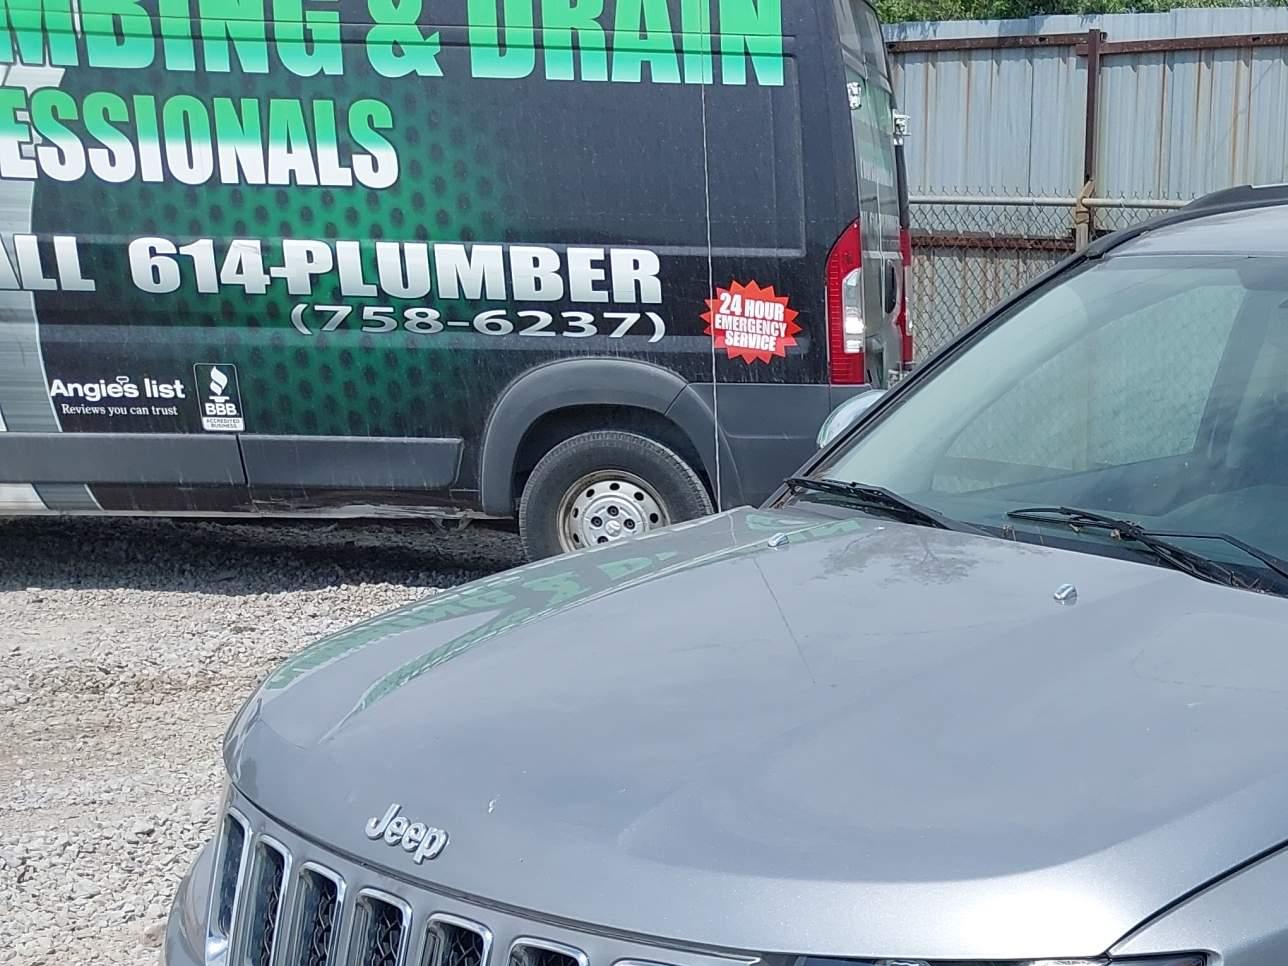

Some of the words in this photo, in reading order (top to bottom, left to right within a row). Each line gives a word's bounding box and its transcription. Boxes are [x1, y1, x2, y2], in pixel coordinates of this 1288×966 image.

[366, 0, 444, 78] &
[467, 0, 784, 86] DRAIN
[0, 87, 399, 189] ESSIONALS
[128, 237, 662, 304] 614-PLUMBER
[719, 292, 742, 316] 24
[744, 299, 785, 321] HOUR
[290, 304, 666, 343] (758-6237)
[714, 313, 787, 338] EMERGENCY
[724, 330, 777, 352] SERVICE
[144, 378, 186, 399] list
[61, 403, 106, 415] Reviews
[109, 406, 128, 417] you
[131, 406, 150, 416] can
[151, 405, 178, 416] trust
[204, 402, 238, 416] BBB
[365, 802, 450, 866] Jeep
